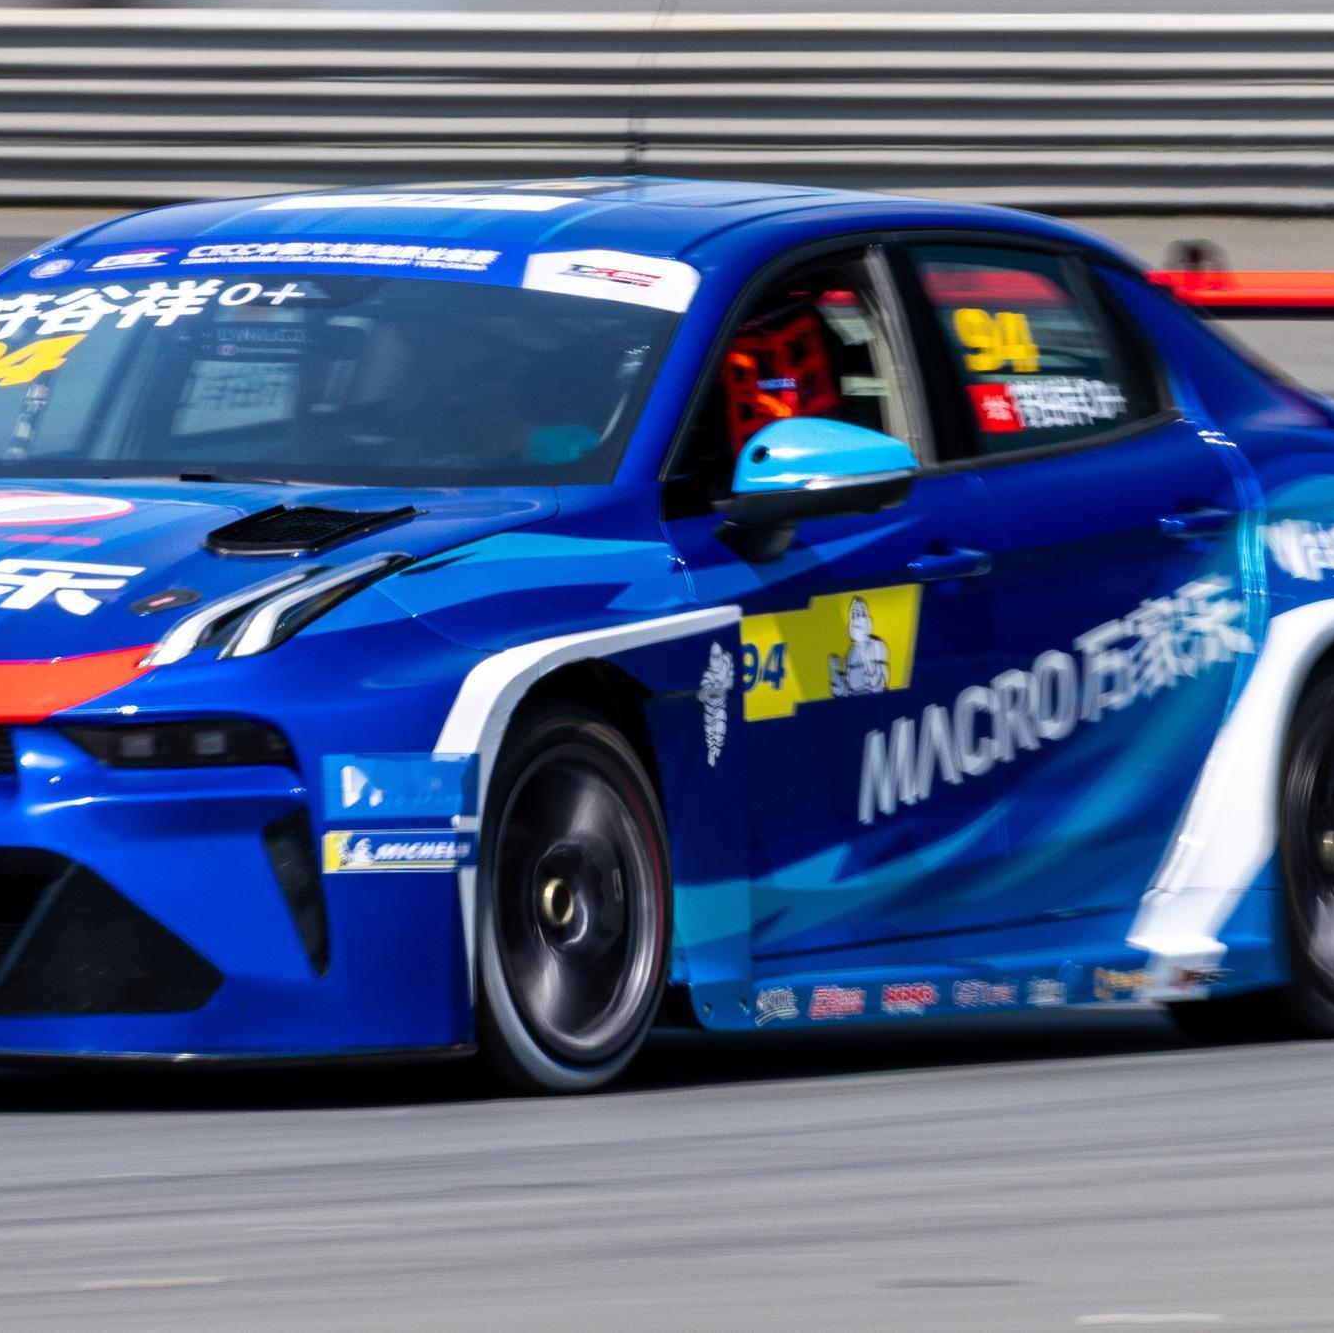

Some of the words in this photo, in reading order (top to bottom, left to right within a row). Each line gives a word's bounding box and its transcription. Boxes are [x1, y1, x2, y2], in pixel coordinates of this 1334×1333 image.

[953, 308, 1041, 373] 94
[740, 643, 786, 691] 94
[857, 649, 1078, 825] MACRO
